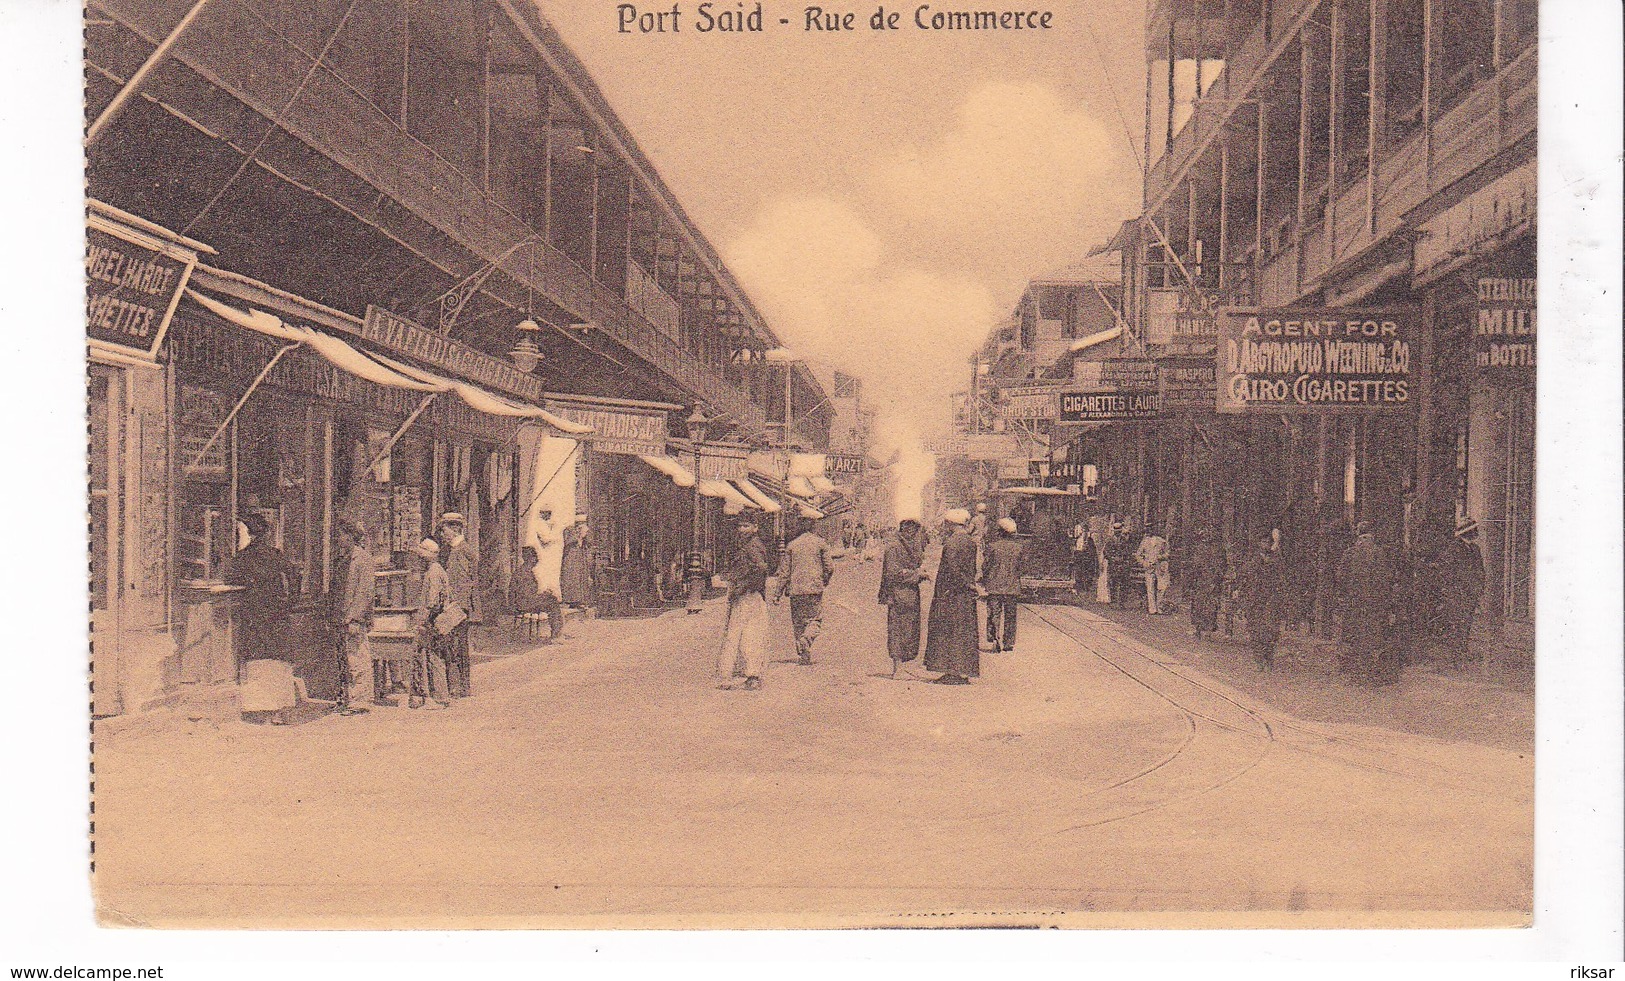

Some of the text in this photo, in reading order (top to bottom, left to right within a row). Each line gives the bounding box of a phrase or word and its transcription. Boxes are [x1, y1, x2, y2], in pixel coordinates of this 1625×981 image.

[1478, 278, 1536, 300] STERILIZ
[1242, 317, 1397, 336] AGENT FOR
[1490, 343, 1536, 365] BOTTL
[1228, 374, 1288, 404] CAIRO
[1294, 374, 1408, 404] CIGARETTES
[1063, 395, 1125, 411] CIGARETTES
